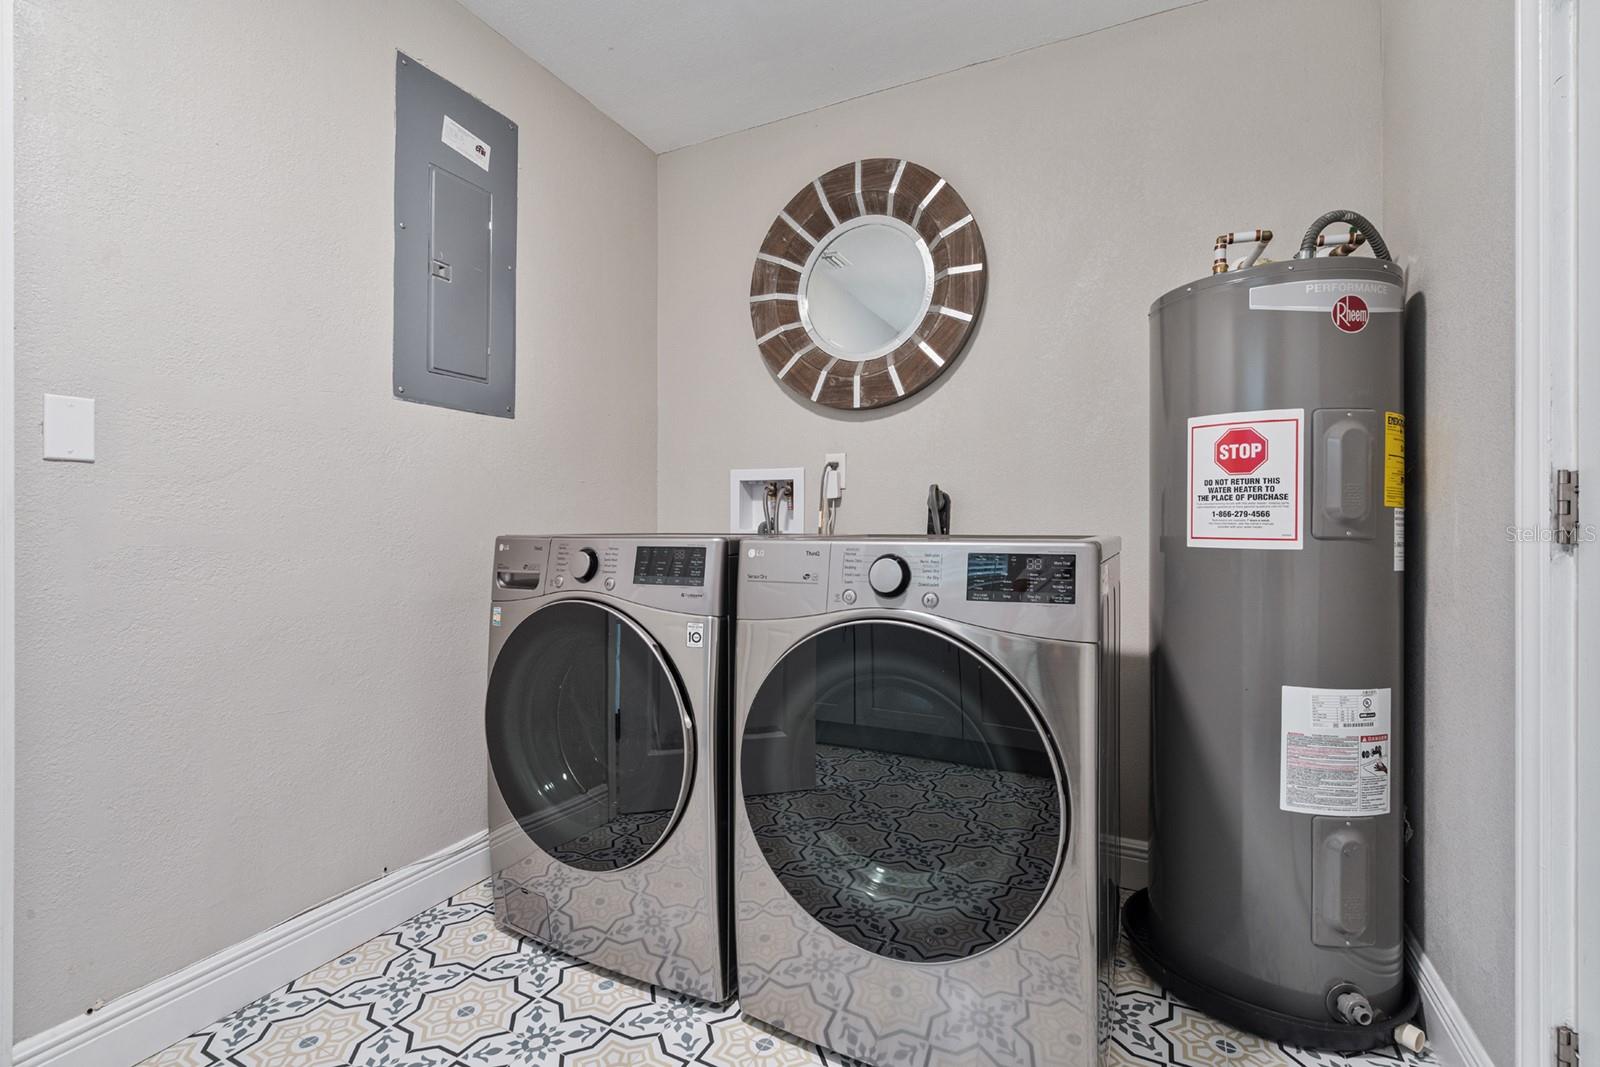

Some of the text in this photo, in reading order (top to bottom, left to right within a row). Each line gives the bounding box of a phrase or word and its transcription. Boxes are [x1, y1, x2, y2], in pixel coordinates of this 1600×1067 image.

[1305, 282, 1388, 295] PERFORMANCE
[1336, 295, 1367, 327] Rheem
[1219, 443, 1262, 460] STOP
[1204, 477, 1281, 487] DO NOT RETURN THIS
[1207, 485, 1275, 494] WATER HEATER TO
[1197, 493, 1289, 502] THE PLACE OF PURCHASE
[1212, 510, 1271, 518] 1-866-279-4566
